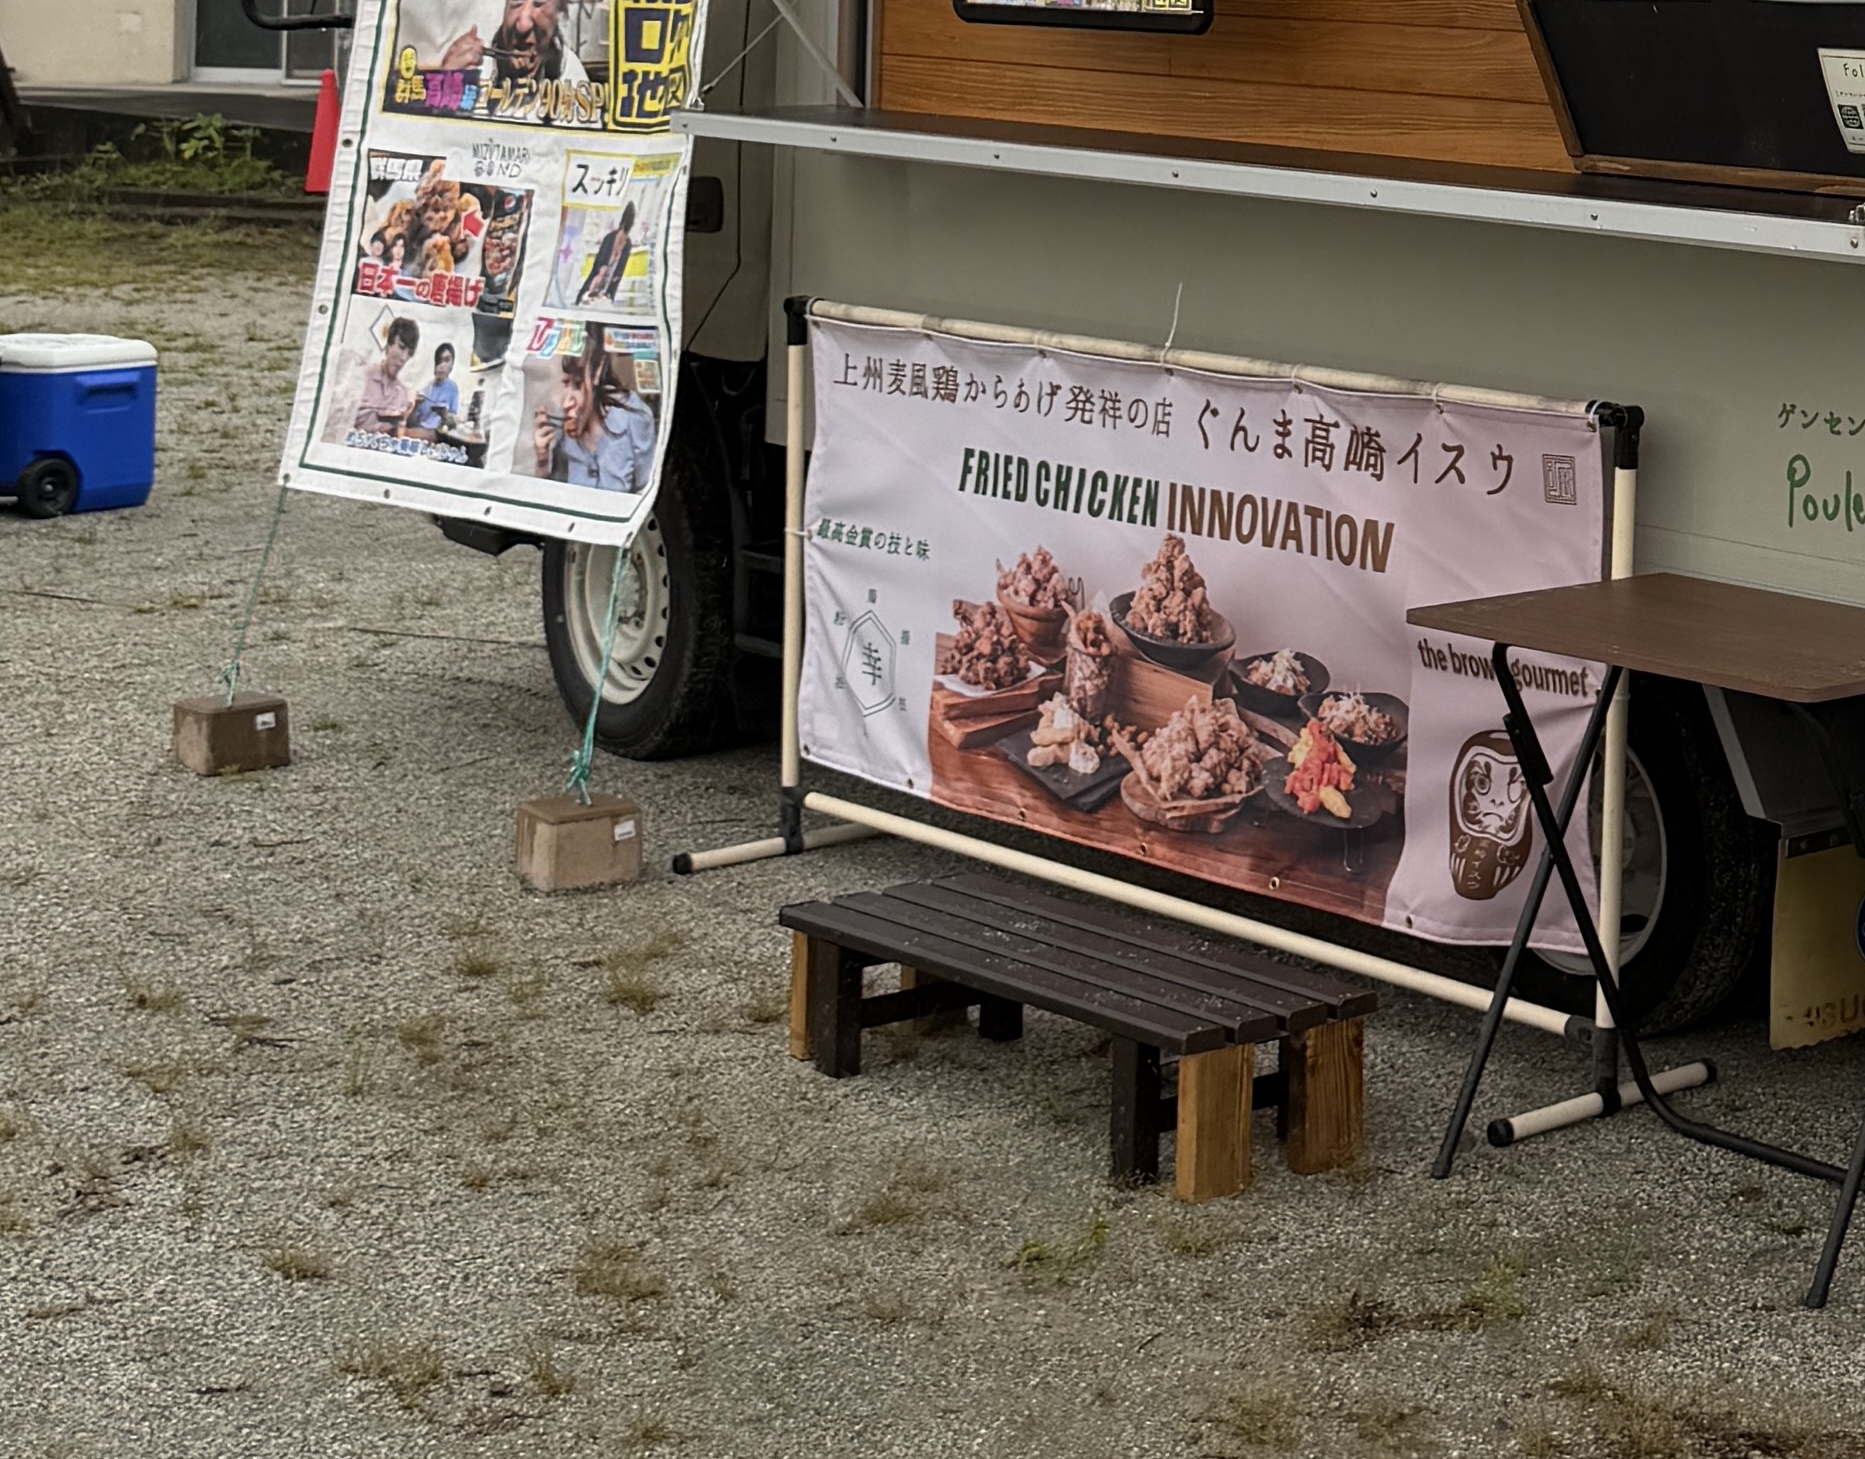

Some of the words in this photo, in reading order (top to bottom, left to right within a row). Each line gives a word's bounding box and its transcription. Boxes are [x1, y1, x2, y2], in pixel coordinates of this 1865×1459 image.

[833, 353, 1174, 438] 上州麦風鶏からあげ発祥の店
[958, 447, 1029, 504] FRIED
[1035, 459, 1160, 528] CHICKEN
[1166, 481, 1395, 574] INNOVATION
[1418, 638, 1448, 670] the
[1448, 643, 1496, 681] brow
[1510, 658, 1589, 698] gourmet
